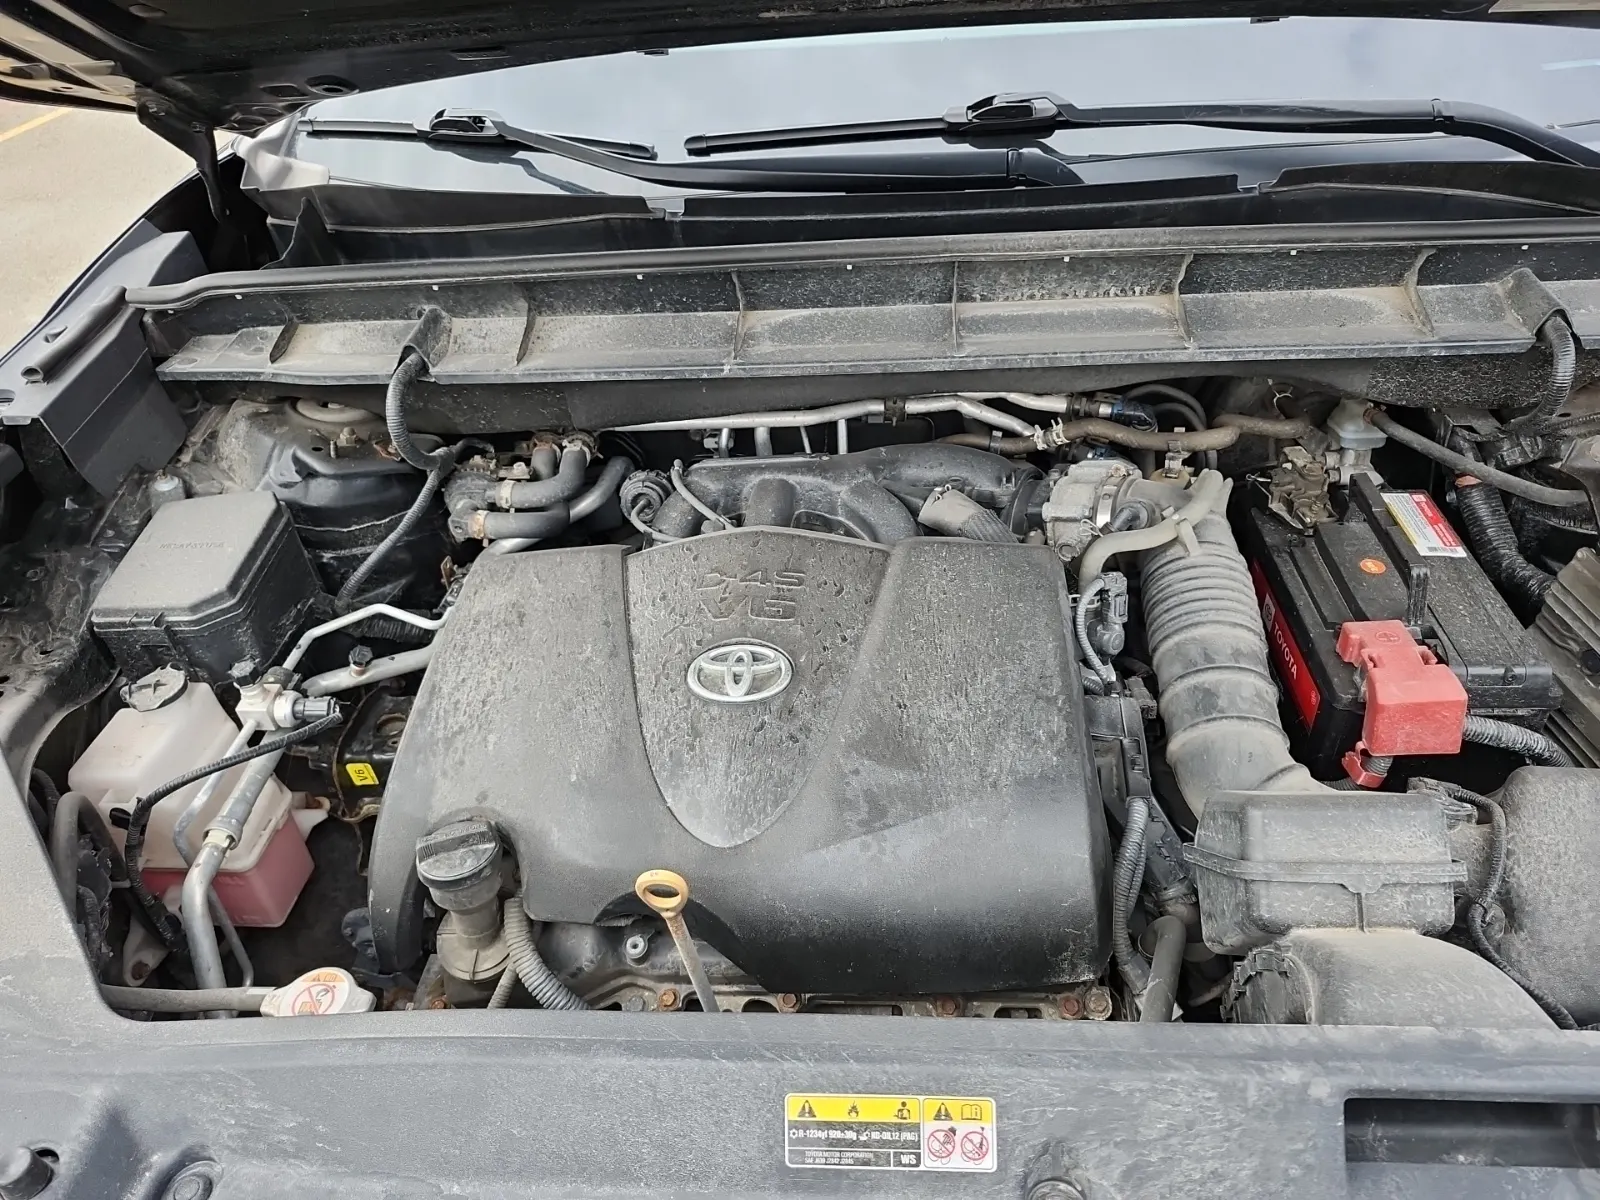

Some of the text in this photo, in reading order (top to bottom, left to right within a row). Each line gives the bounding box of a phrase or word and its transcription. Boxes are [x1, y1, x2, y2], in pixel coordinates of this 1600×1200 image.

[699, 595, 797, 621] V6
[1273, 622, 1298, 680] TOYOTA
[354, 769, 369, 782] V6
[798, 1129, 828, 1140] R-1234yf
[900, 1131, 918, 1142] (PAG)
[900, 1154, 917, 1165] WS
